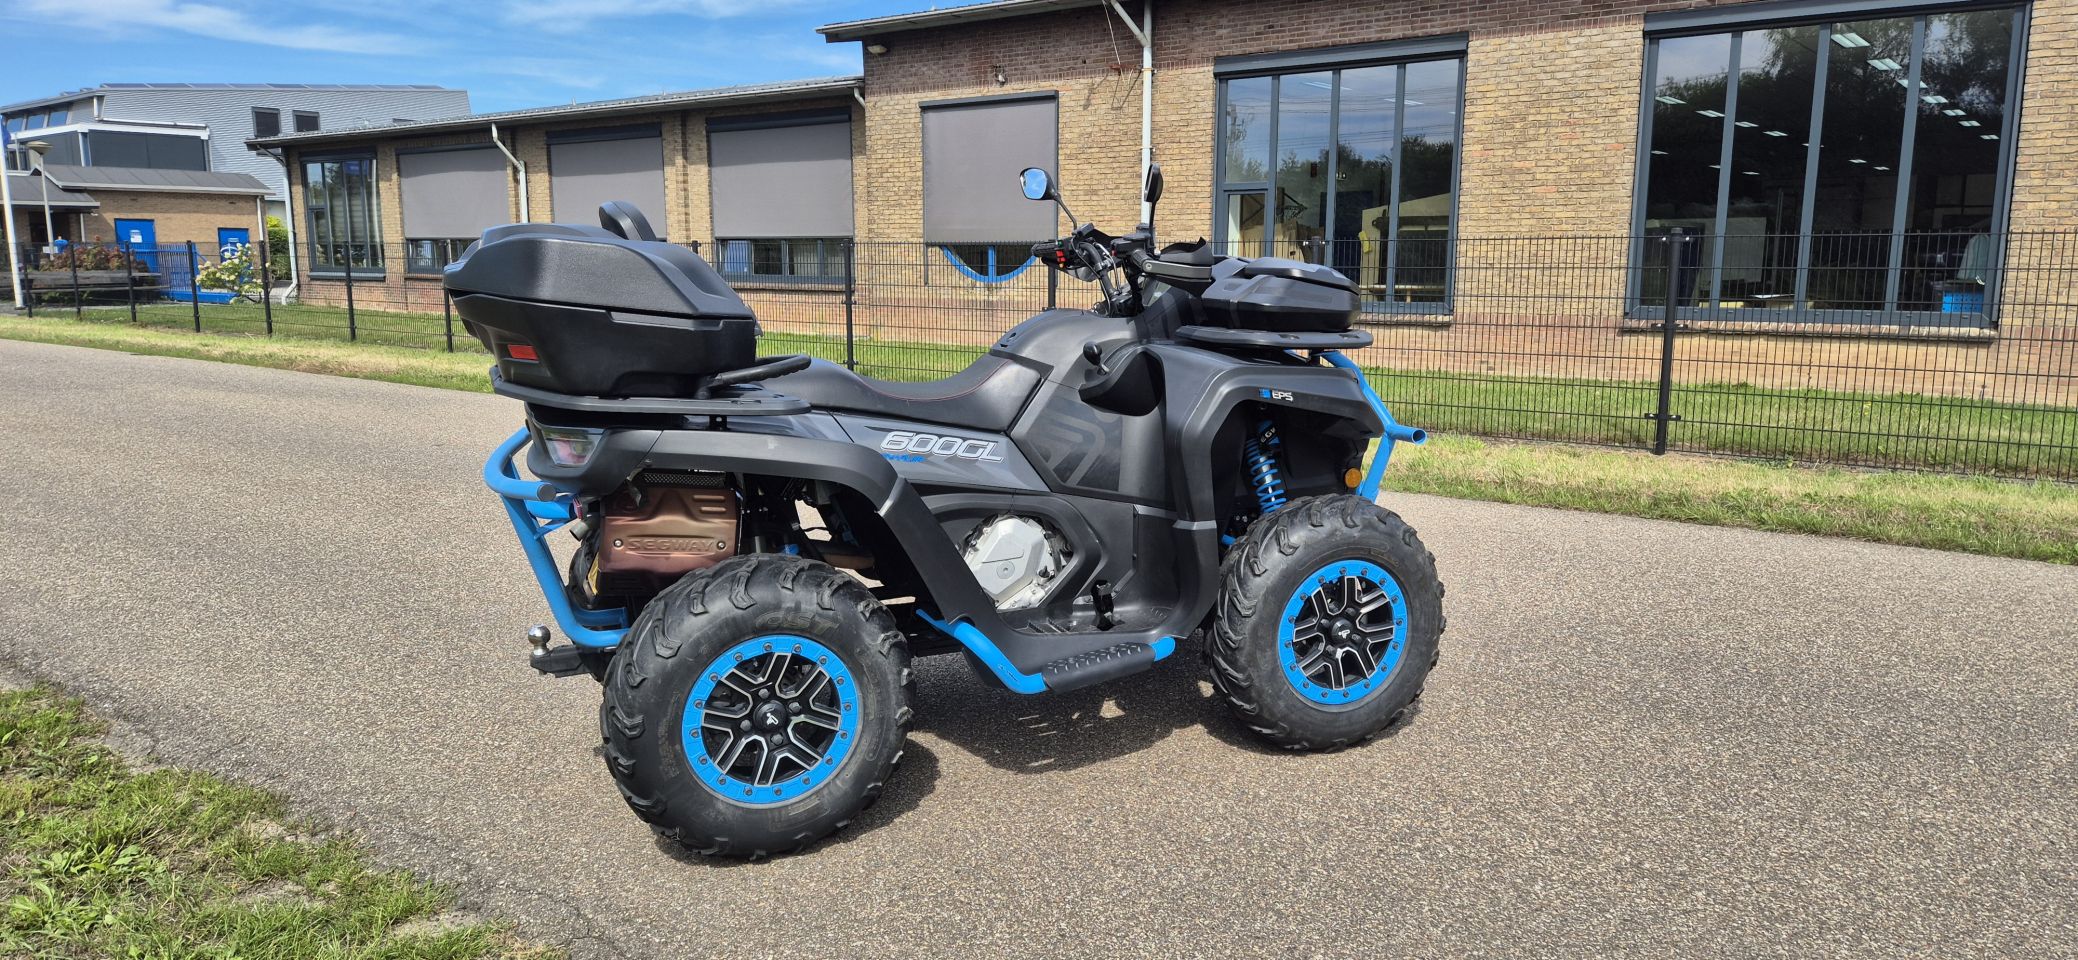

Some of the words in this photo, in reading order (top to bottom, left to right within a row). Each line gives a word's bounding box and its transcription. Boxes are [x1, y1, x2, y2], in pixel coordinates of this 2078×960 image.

[1271, 389, 1294, 402] EPS
[880, 430, 1004, 462] 600GL
[627, 539, 714, 552] SEGWAY
